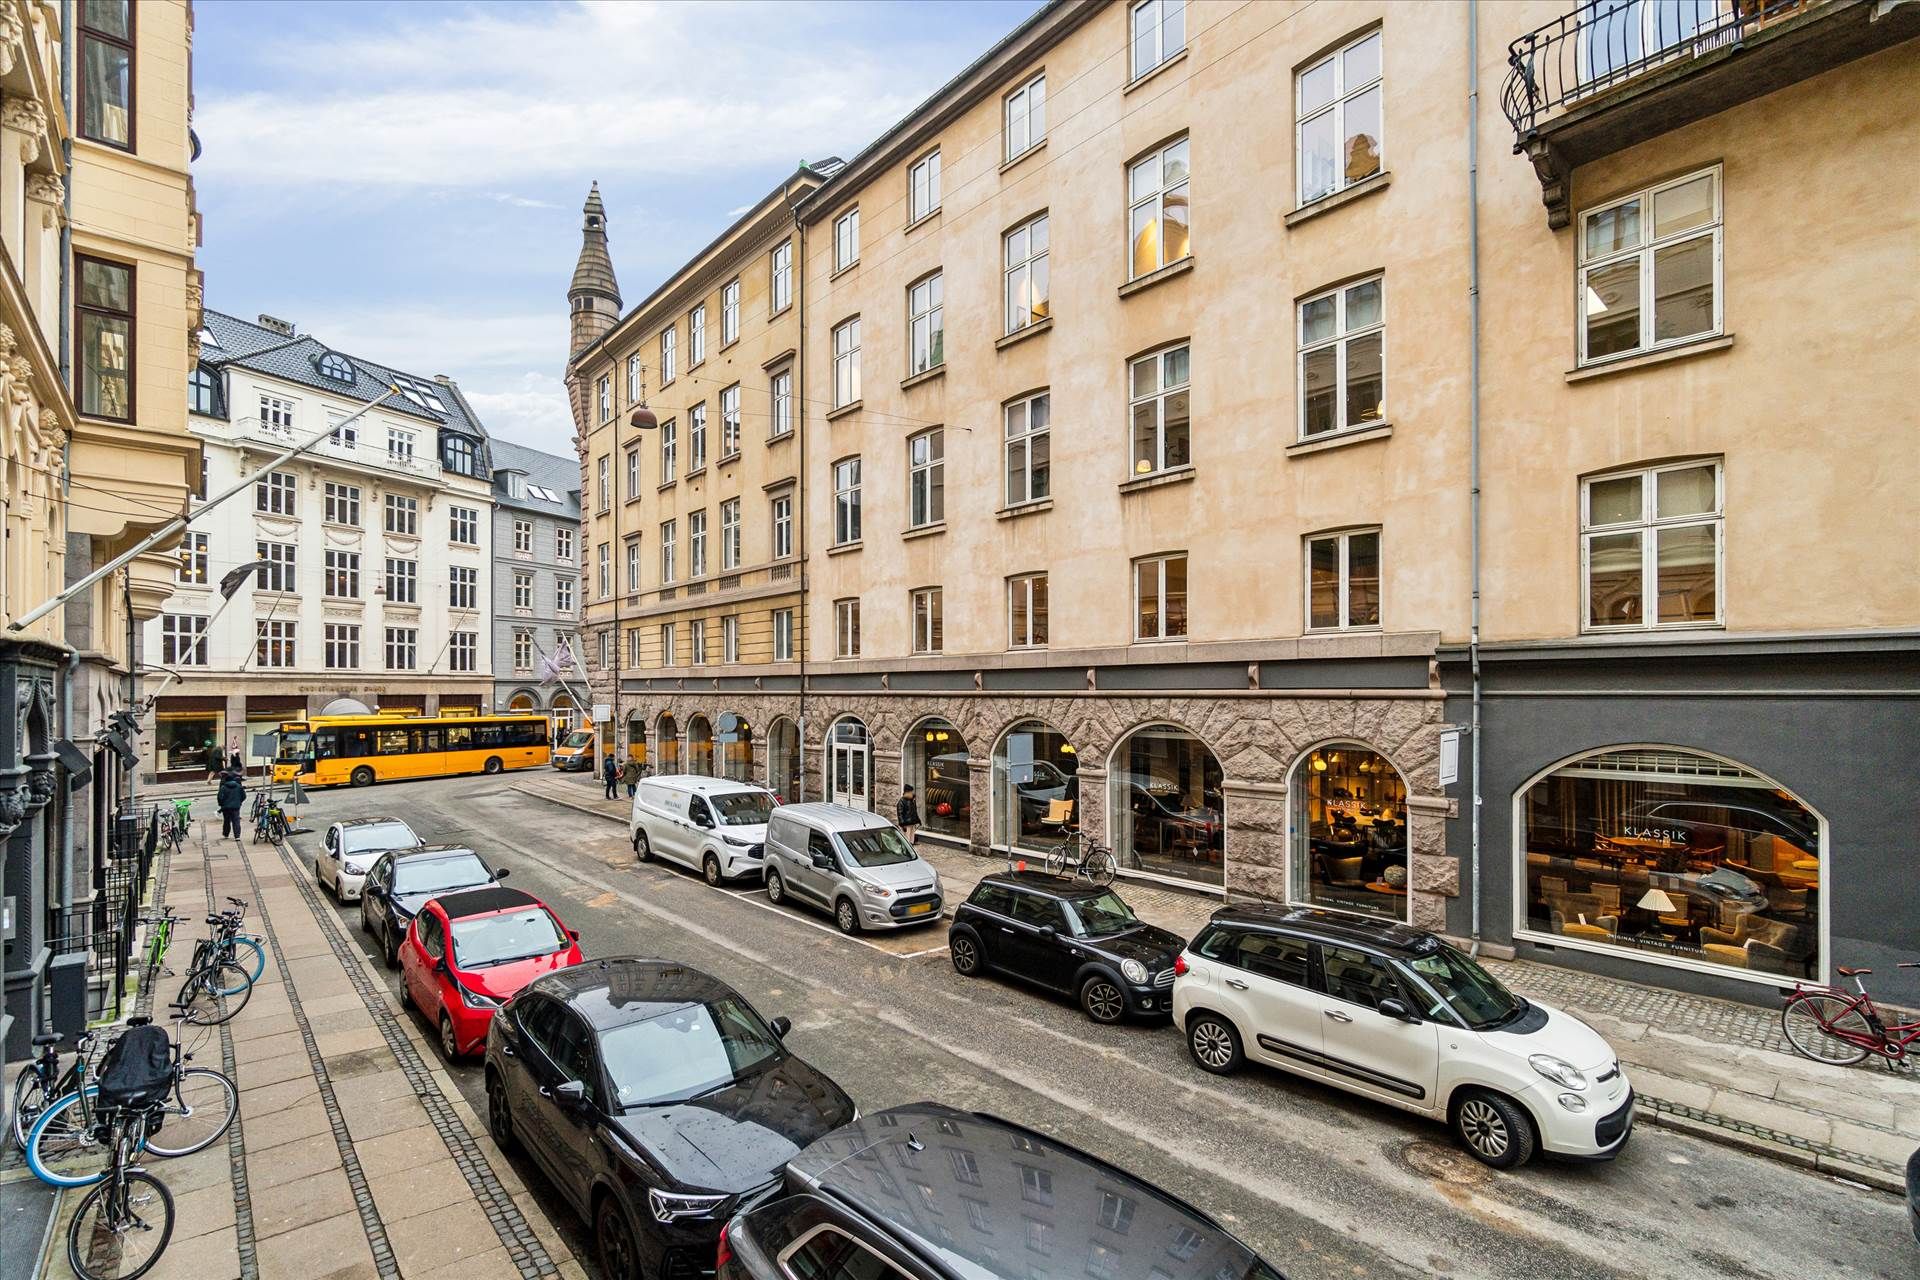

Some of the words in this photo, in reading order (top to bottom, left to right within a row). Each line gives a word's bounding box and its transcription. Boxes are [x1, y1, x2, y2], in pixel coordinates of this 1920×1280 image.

[1150, 782, 1179, 791] KLASSIK
[1326, 799, 1367, 809] KLASSIK
[1624, 826, 1687, 841] KLASSIK
[1606, 933, 1636, 943] ORIGINAL
[1639, 939, 1667, 948] VINTAGE
[1671, 944, 1708, 954] FURNITURE
